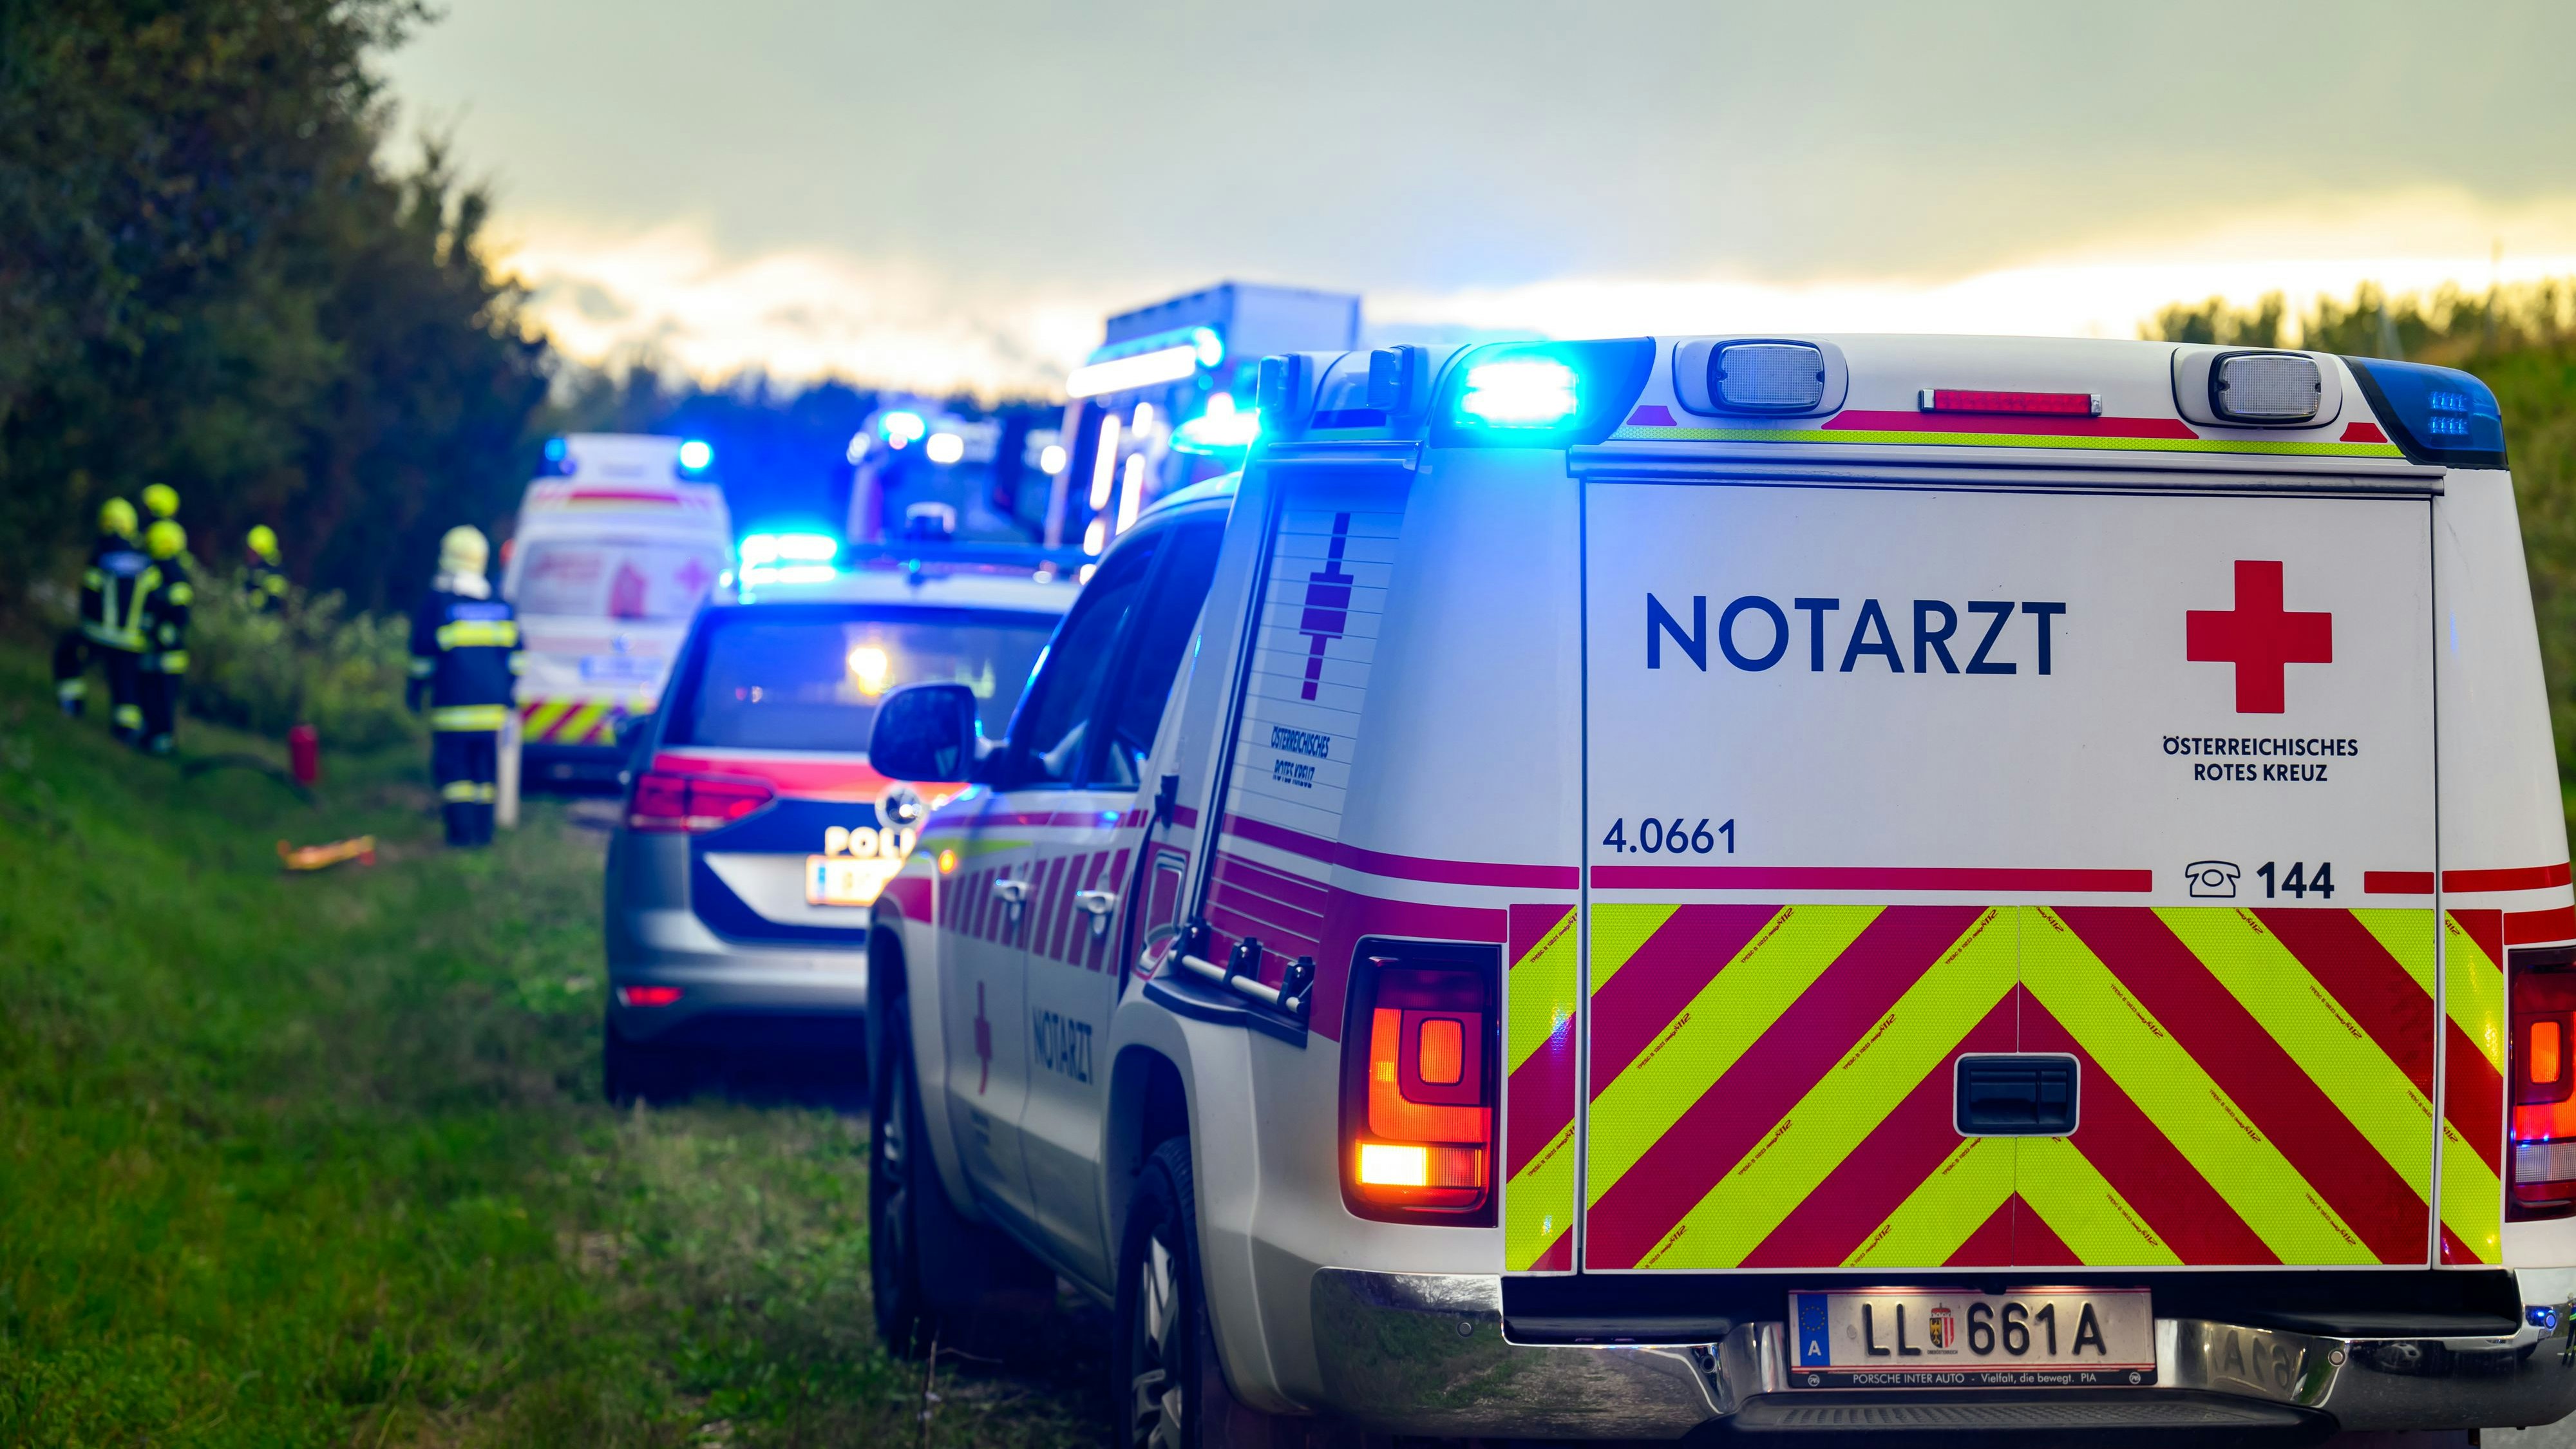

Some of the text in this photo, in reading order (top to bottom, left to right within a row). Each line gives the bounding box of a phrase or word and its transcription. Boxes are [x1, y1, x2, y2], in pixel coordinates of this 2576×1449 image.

[1647, 592, 2066, 675] NOTARZT
[1271, 725, 1331, 759] ÖSTERREICHISCHES
[2163, 735, 2358, 757] ÖSTERREICHISCHES
[1273, 759, 1315, 789] ROTES KREUZ
[2194, 763, 2327, 782] ROTES KREUZ
[825, 826, 916, 858] POLI
[1602, 818, 1736, 854] 4.0661
[2256, 862, 2335, 899] 144
[1032, 1006, 1093, 1086] NOTARZT
[1862, 1302, 2107, 1356] LL 661A
[1808, 1340, 1822, 1356] A
[1853, 1374, 1900, 1384] PORSCHE
[1904, 1373, 1933, 1383] INTER
[1936, 1373, 1965, 1383] AUTO
[1980, 1372, 2016, 1384] Vielfalt,
[2020, 1372, 2034, 1383] die
[2037, 1372, 2074, 1385] bewegt.
[2081, 1373, 2097, 1383] PIA
